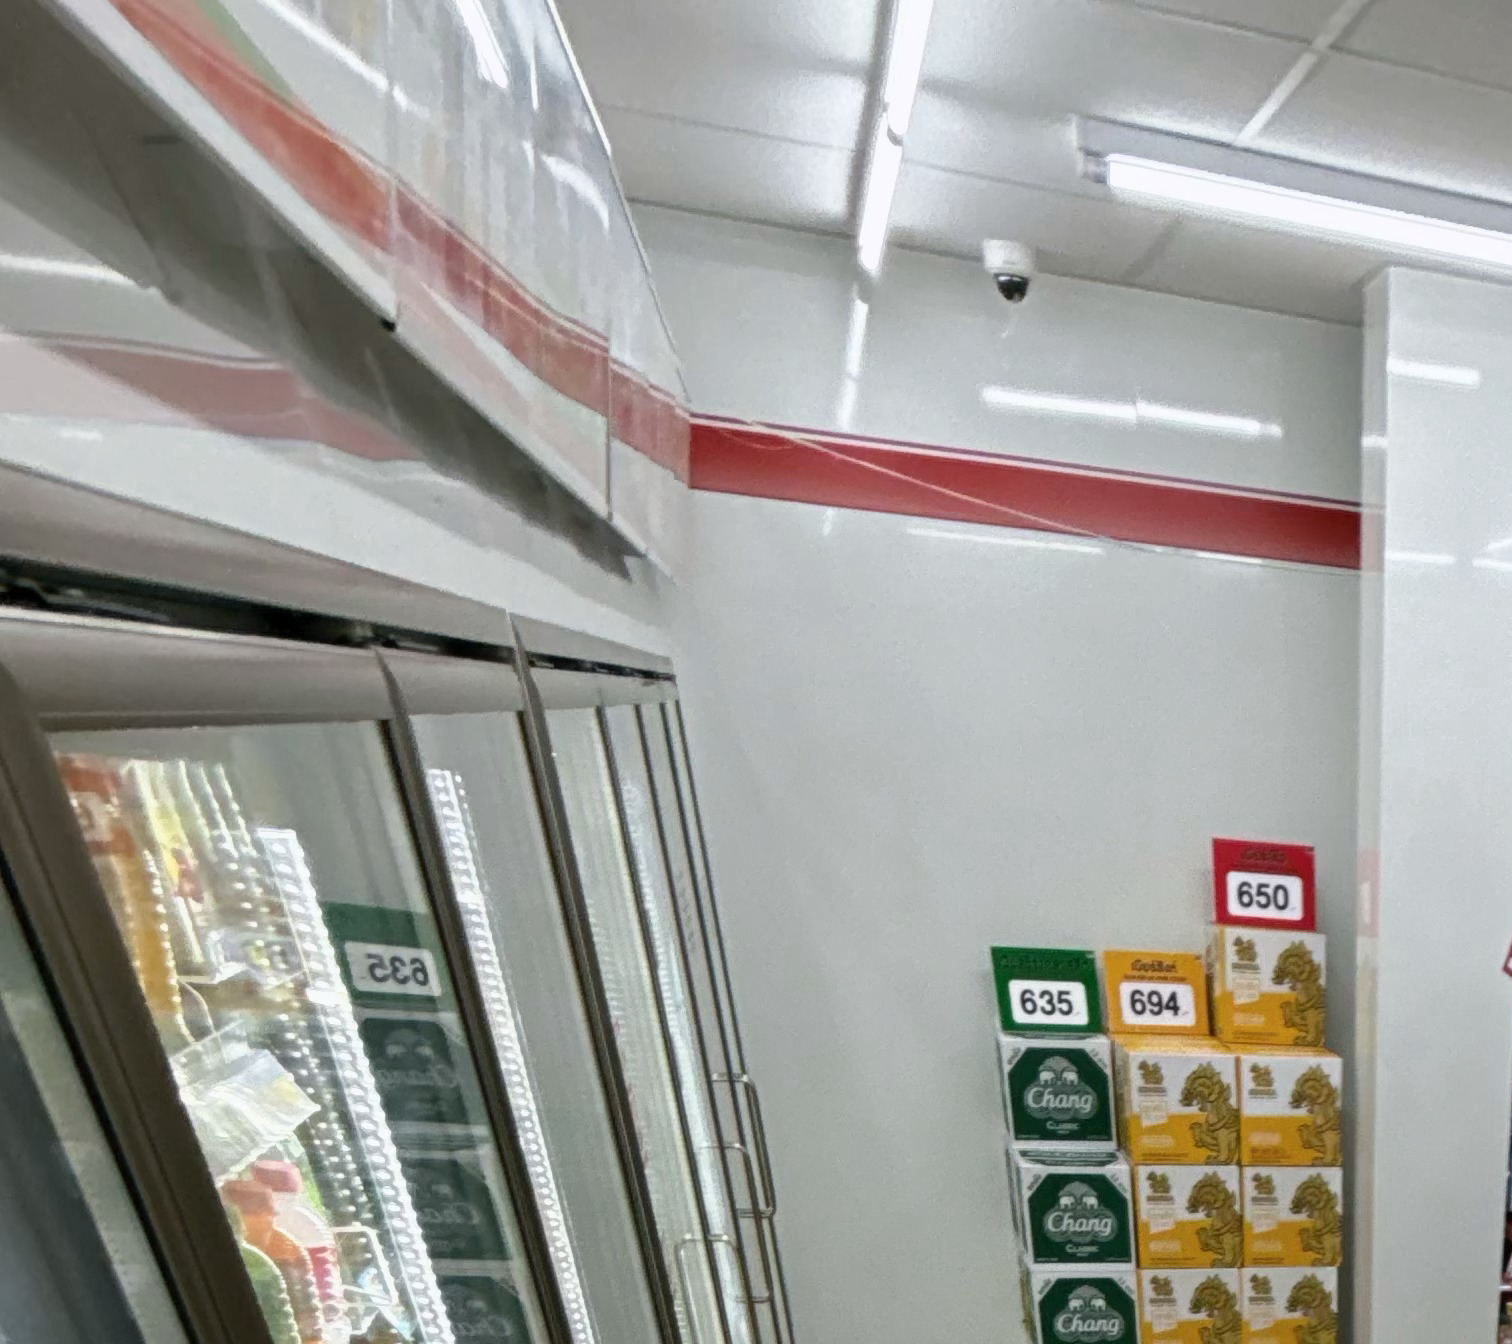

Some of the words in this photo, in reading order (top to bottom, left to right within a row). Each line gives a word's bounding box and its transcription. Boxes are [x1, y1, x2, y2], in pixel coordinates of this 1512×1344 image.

[1236, 880, 1290, 911] 650
[1019, 988, 1074, 1017] 635
[1129, 988, 1181, 1018] 694
[1026, 1086, 1093, 1114] Chang
[1047, 1210, 1114, 1237] Chang
[1055, 1313, 1120, 1336] Chang
